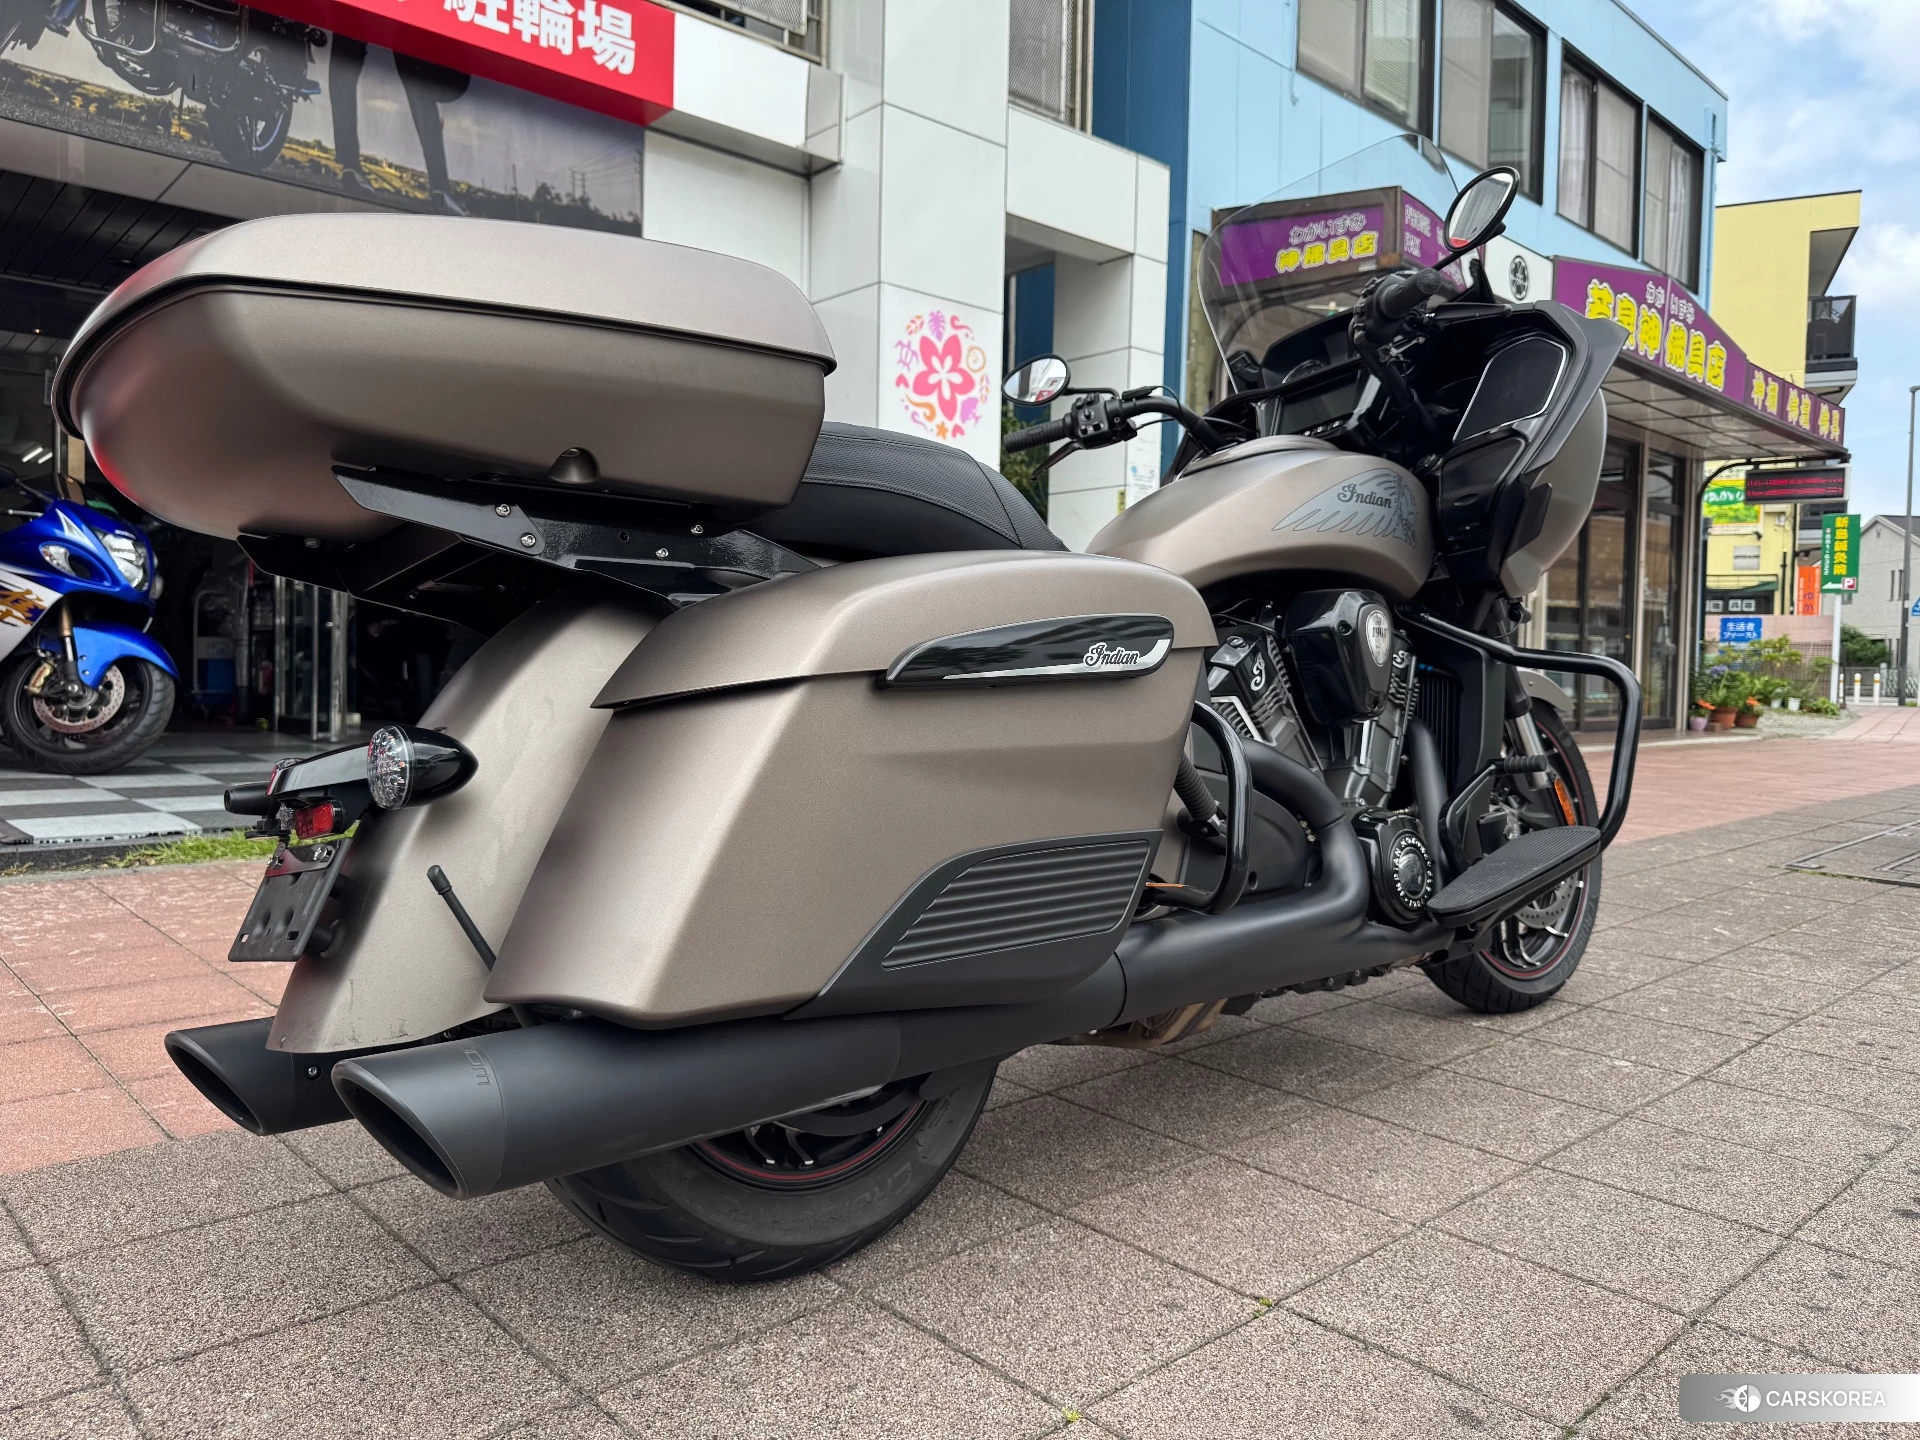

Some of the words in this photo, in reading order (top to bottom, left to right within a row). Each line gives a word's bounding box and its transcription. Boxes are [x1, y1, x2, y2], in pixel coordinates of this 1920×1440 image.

[1289, 212, 1367, 245] わかいずみ
[1337, 483, 1391, 508] Indian
[1083, 642, 1140, 667] Indian
